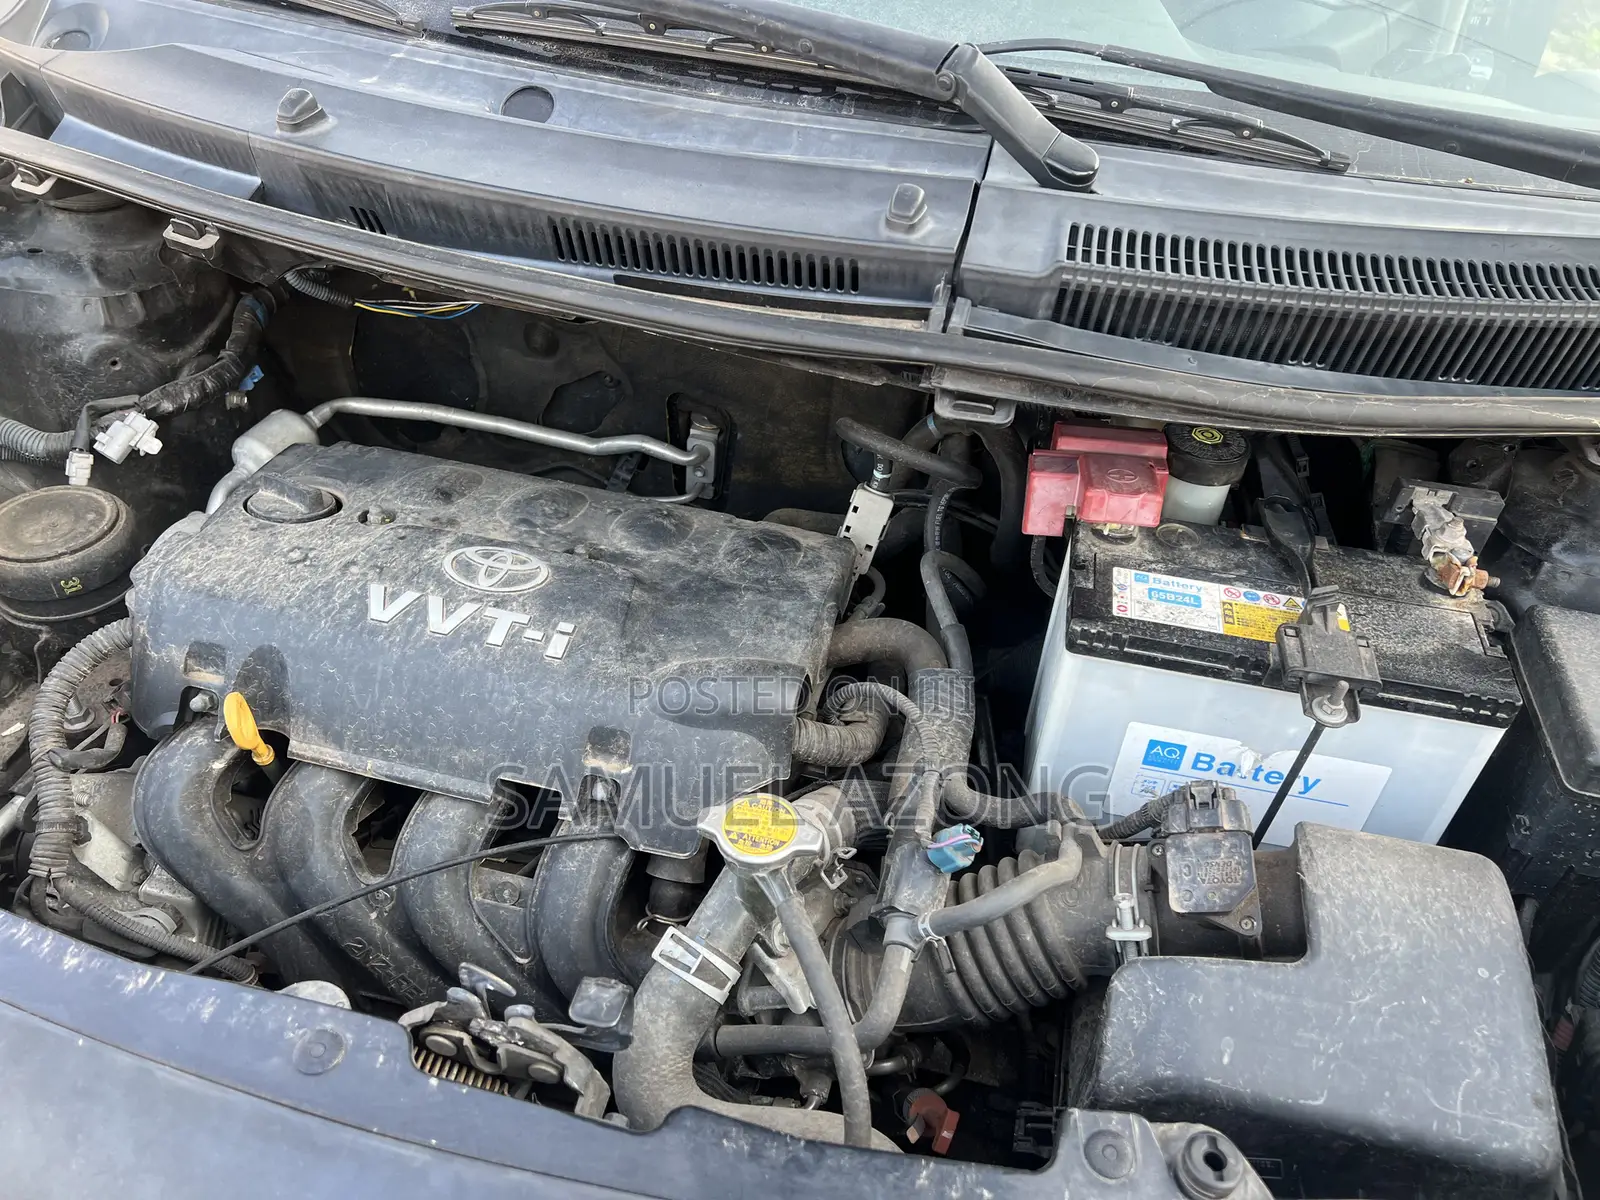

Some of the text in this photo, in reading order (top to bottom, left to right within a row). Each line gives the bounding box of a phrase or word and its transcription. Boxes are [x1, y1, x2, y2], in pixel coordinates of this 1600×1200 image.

[1152, 577, 1203, 593] Battery
[1151, 590, 1200, 605] 65B24L
[369, 583, 577, 660] VVT-i
[1191, 752, 1322, 795] Batey
[751, 803, 786, 814] CAUTION
[742, 833, 781, 847] ATTENTION
[1201, 877, 1242, 885] TOYOTA
